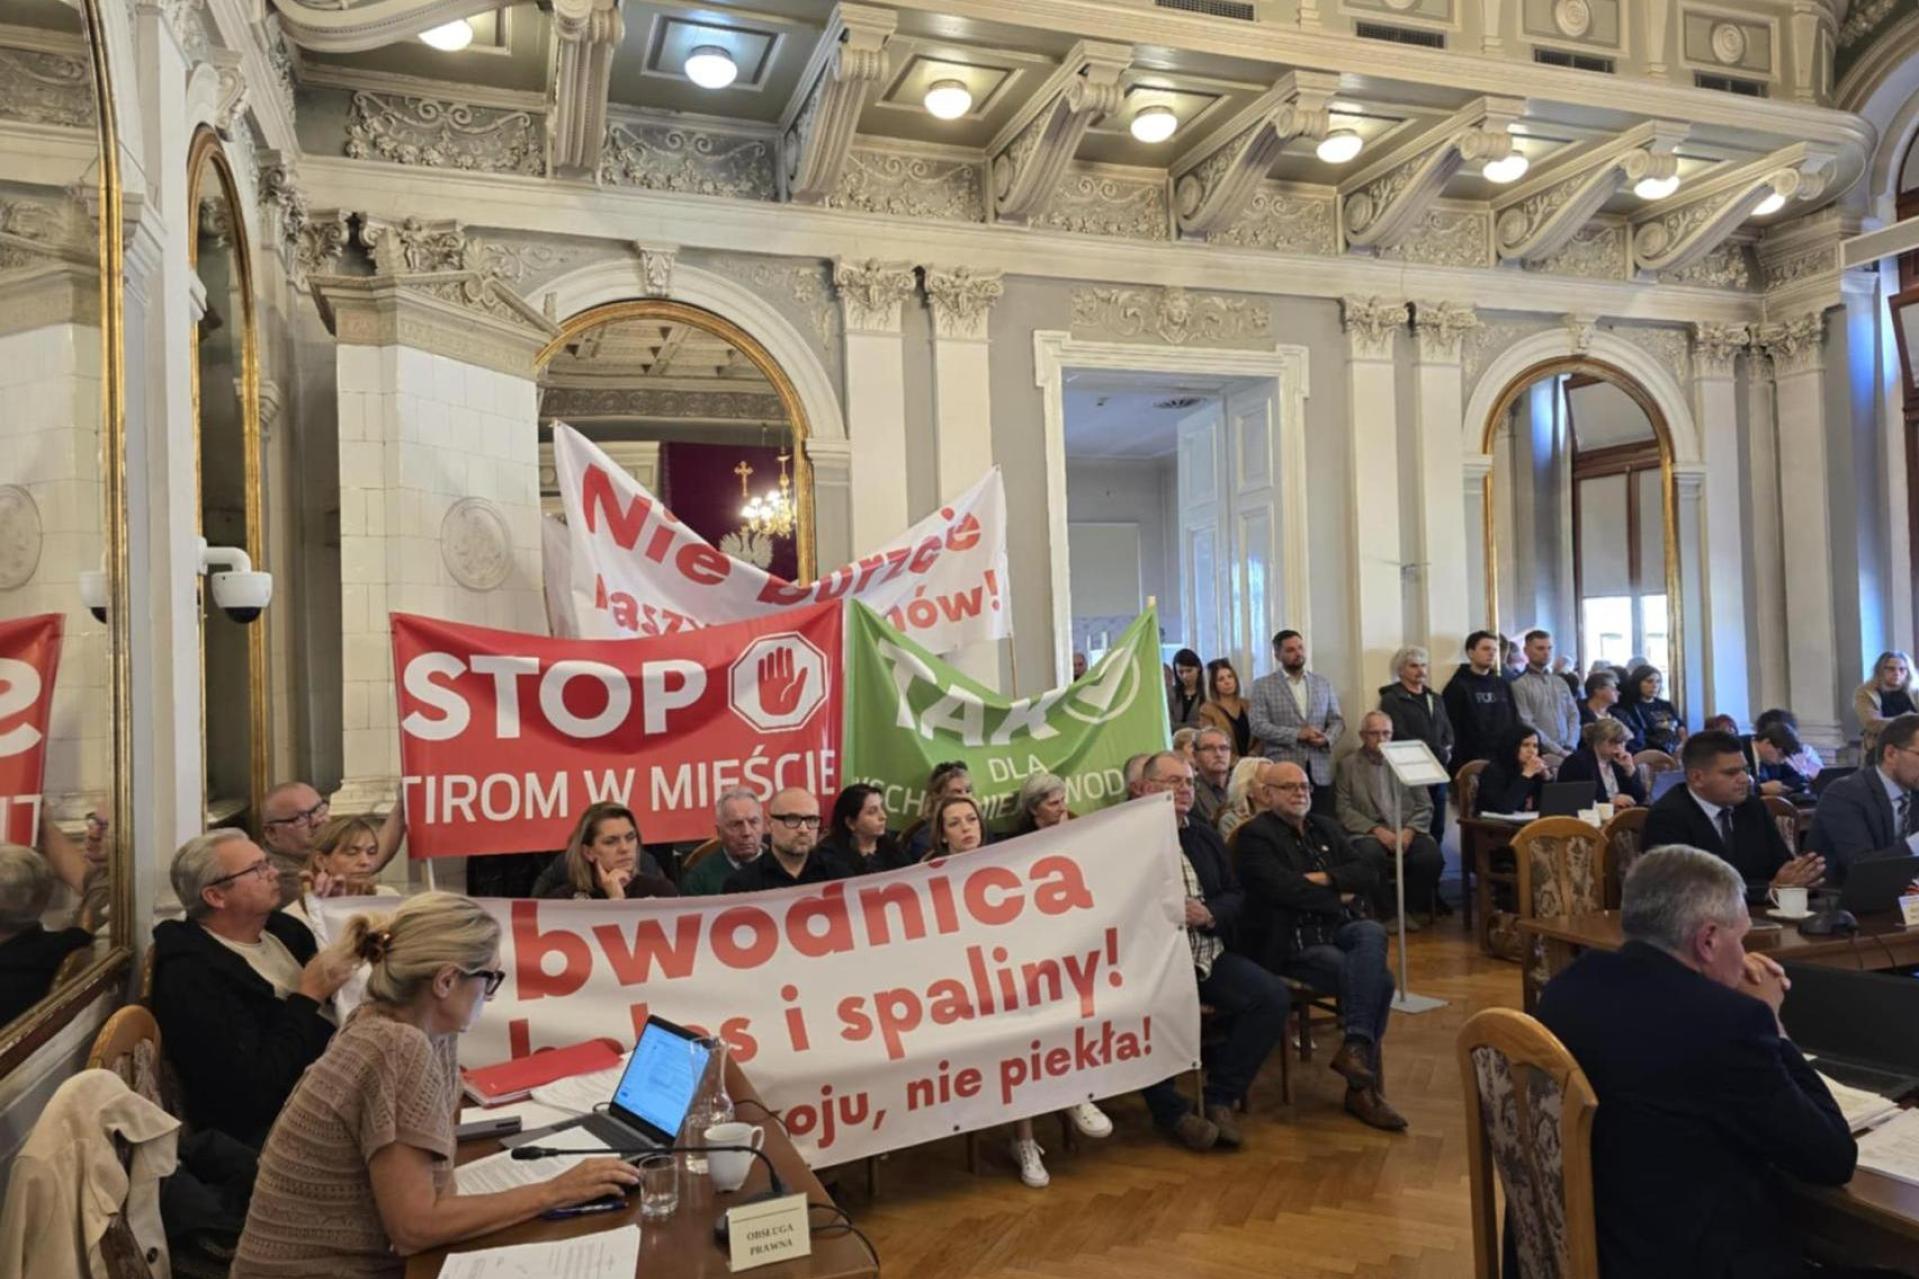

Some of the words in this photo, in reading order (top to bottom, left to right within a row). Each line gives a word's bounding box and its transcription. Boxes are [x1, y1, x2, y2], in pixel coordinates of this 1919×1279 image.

[582, 462, 732, 586] Nie
[402, 652, 707, 741] STOP
[878, 637, 1069, 747] TAK
[400, 770, 568, 825] TIROM
[988, 754, 1049, 784] DLA
[781, 985, 810, 1052] i
[836, 928, 1123, 1061] spaliny!
[907, 1060, 983, 1111] nie
[1000, 1016, 1152, 1105] piekła!
[750, 1239, 793, 1256] PRAWNA
